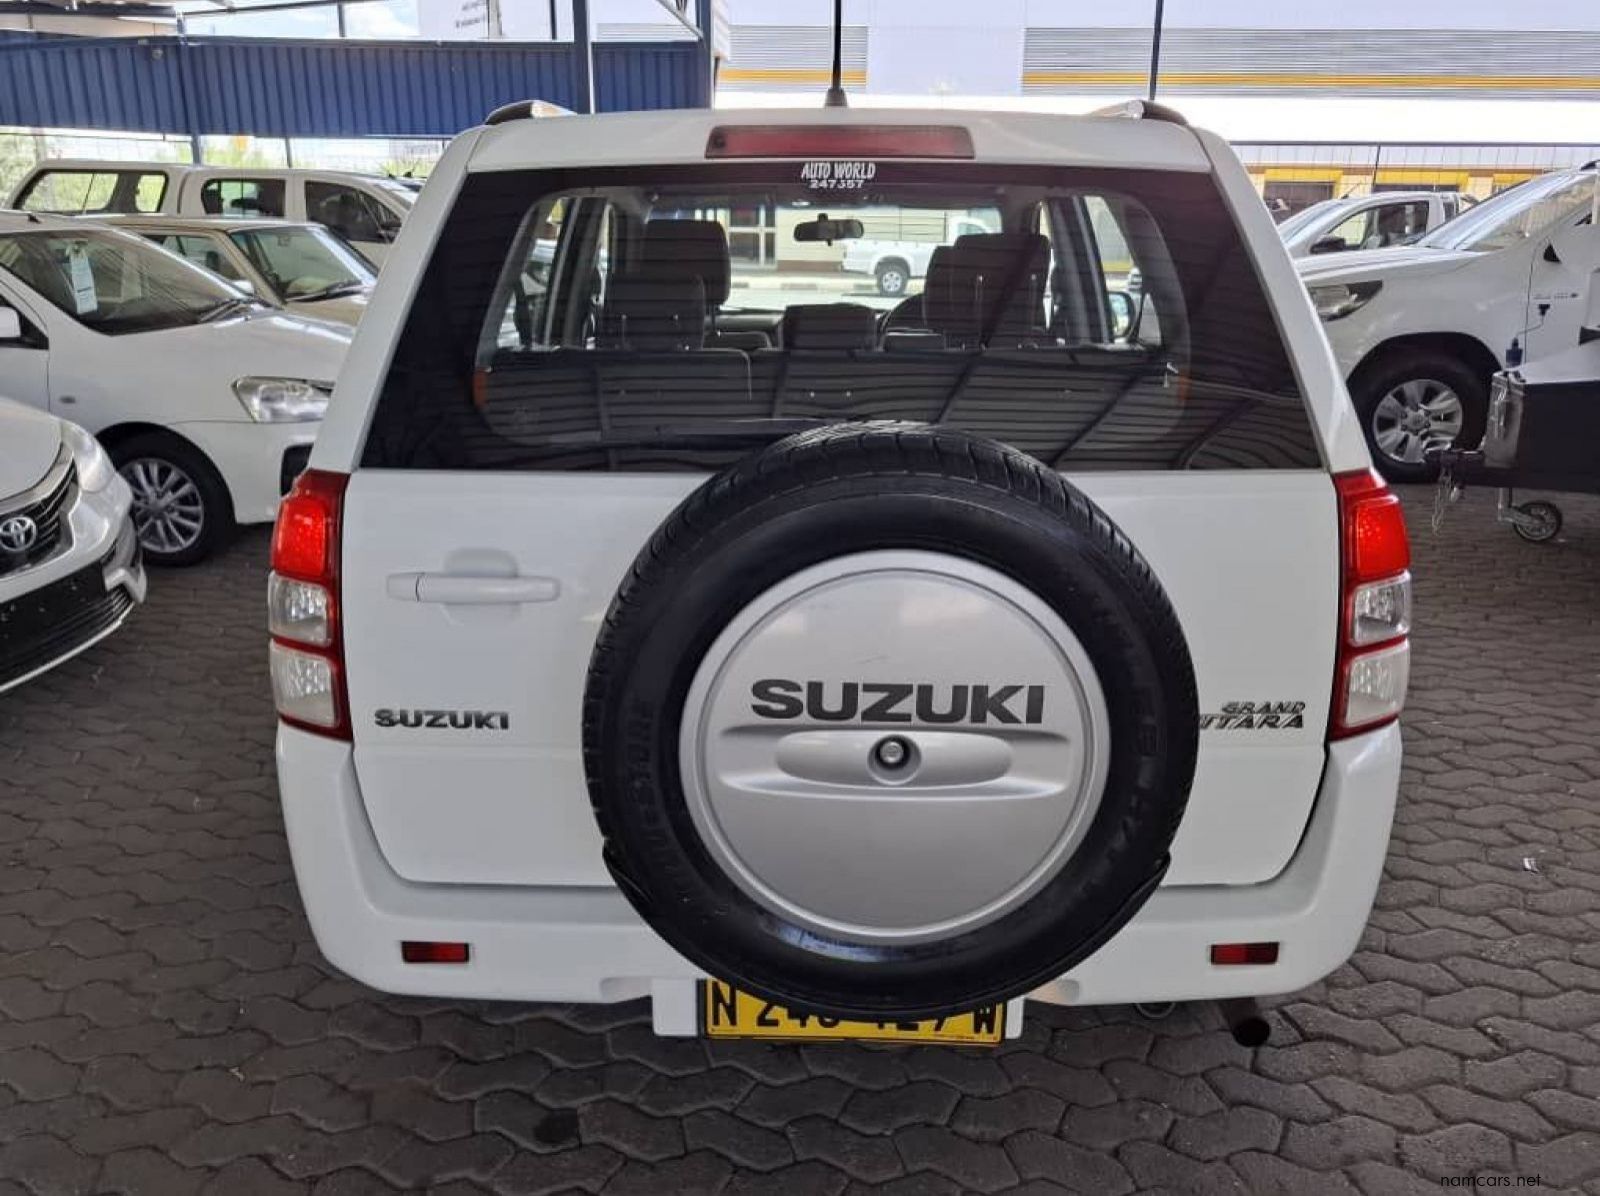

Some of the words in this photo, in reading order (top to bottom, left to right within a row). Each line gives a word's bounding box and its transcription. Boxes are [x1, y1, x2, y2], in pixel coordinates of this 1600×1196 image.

[801, 161, 831, 180] AUTO
[834, 161, 876, 180] WORLD
[751, 678, 1045, 724] SUZUKI
[1221, 701, 1306, 714] GRAND
[374, 708, 509, 730] SUZUKI
[1198, 713, 1304, 729] ITARA
[711, 981, 738, 1026] N
